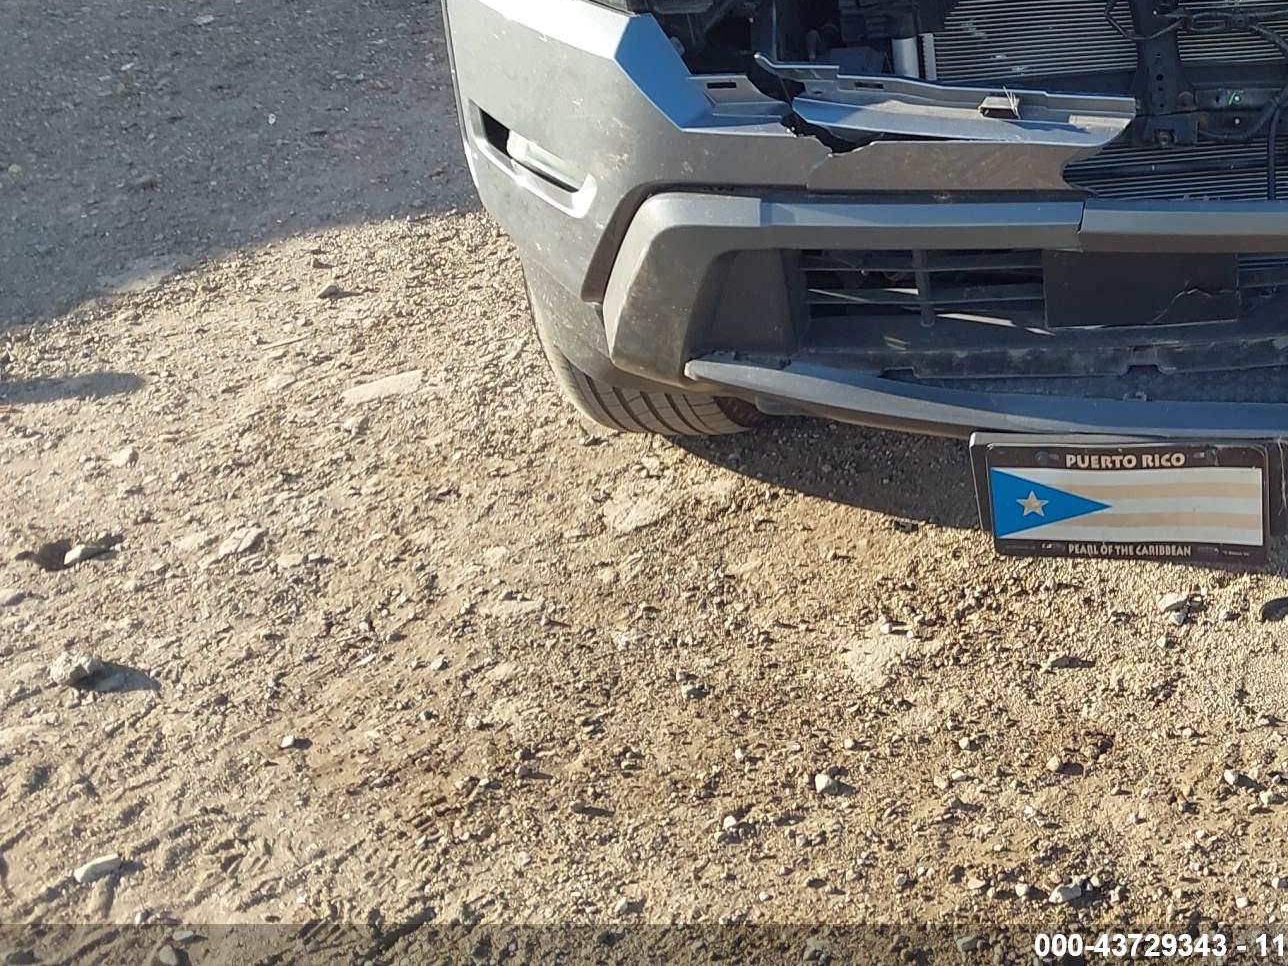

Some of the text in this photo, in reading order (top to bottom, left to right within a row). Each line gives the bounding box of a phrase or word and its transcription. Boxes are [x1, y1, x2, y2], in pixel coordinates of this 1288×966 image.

[1065, 452, 1186, 469] PUERTO RICO
[1068, 544, 1191, 557] PEARL OF THE CARIBBEAN
